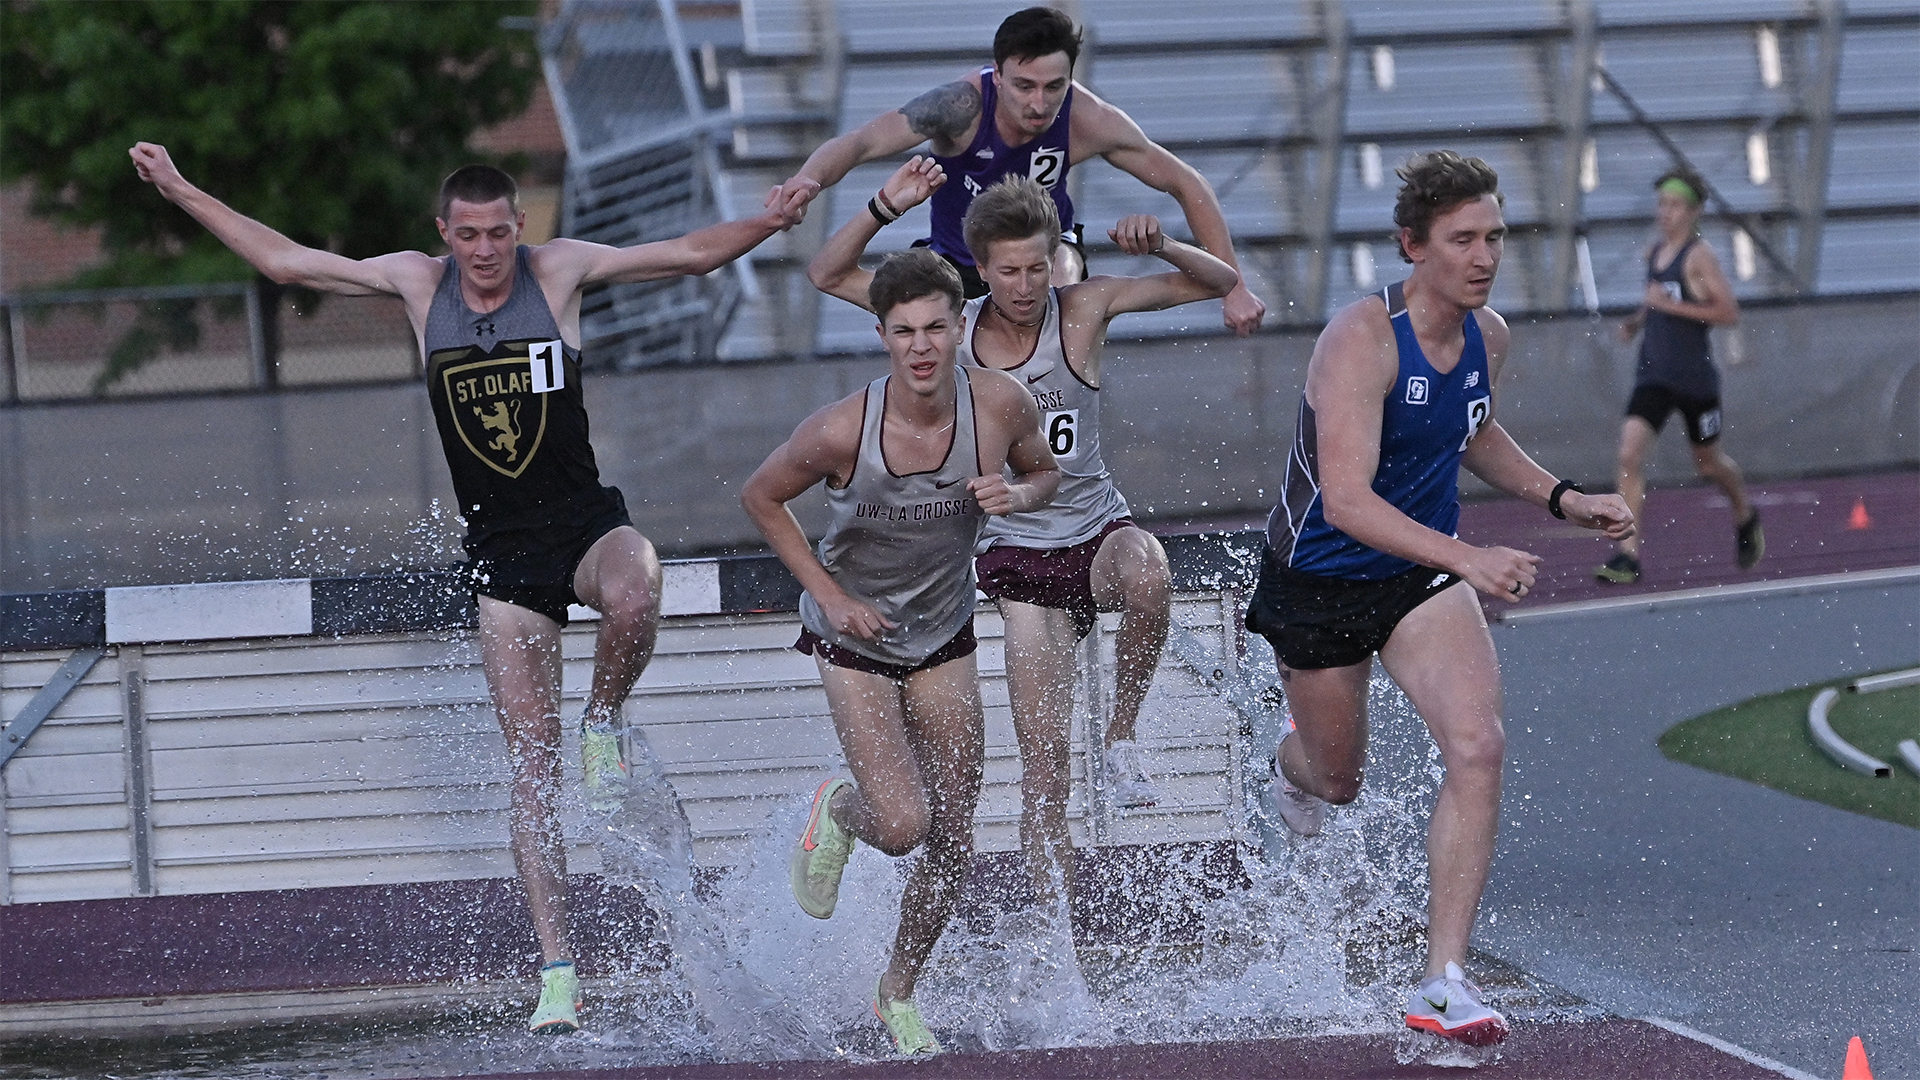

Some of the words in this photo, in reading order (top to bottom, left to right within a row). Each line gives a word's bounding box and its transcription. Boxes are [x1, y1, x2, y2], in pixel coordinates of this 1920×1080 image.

[1034, 154, 1058, 186] 2
[536, 345, 555, 389] 1
[456, 378, 482, 403] ST.
[484, 371, 531, 396] OLAF
[1048, 413, 1074, 455] 6
[856, 503, 907, 521] UW-LA
[913, 499, 969, 521] CROSSE
